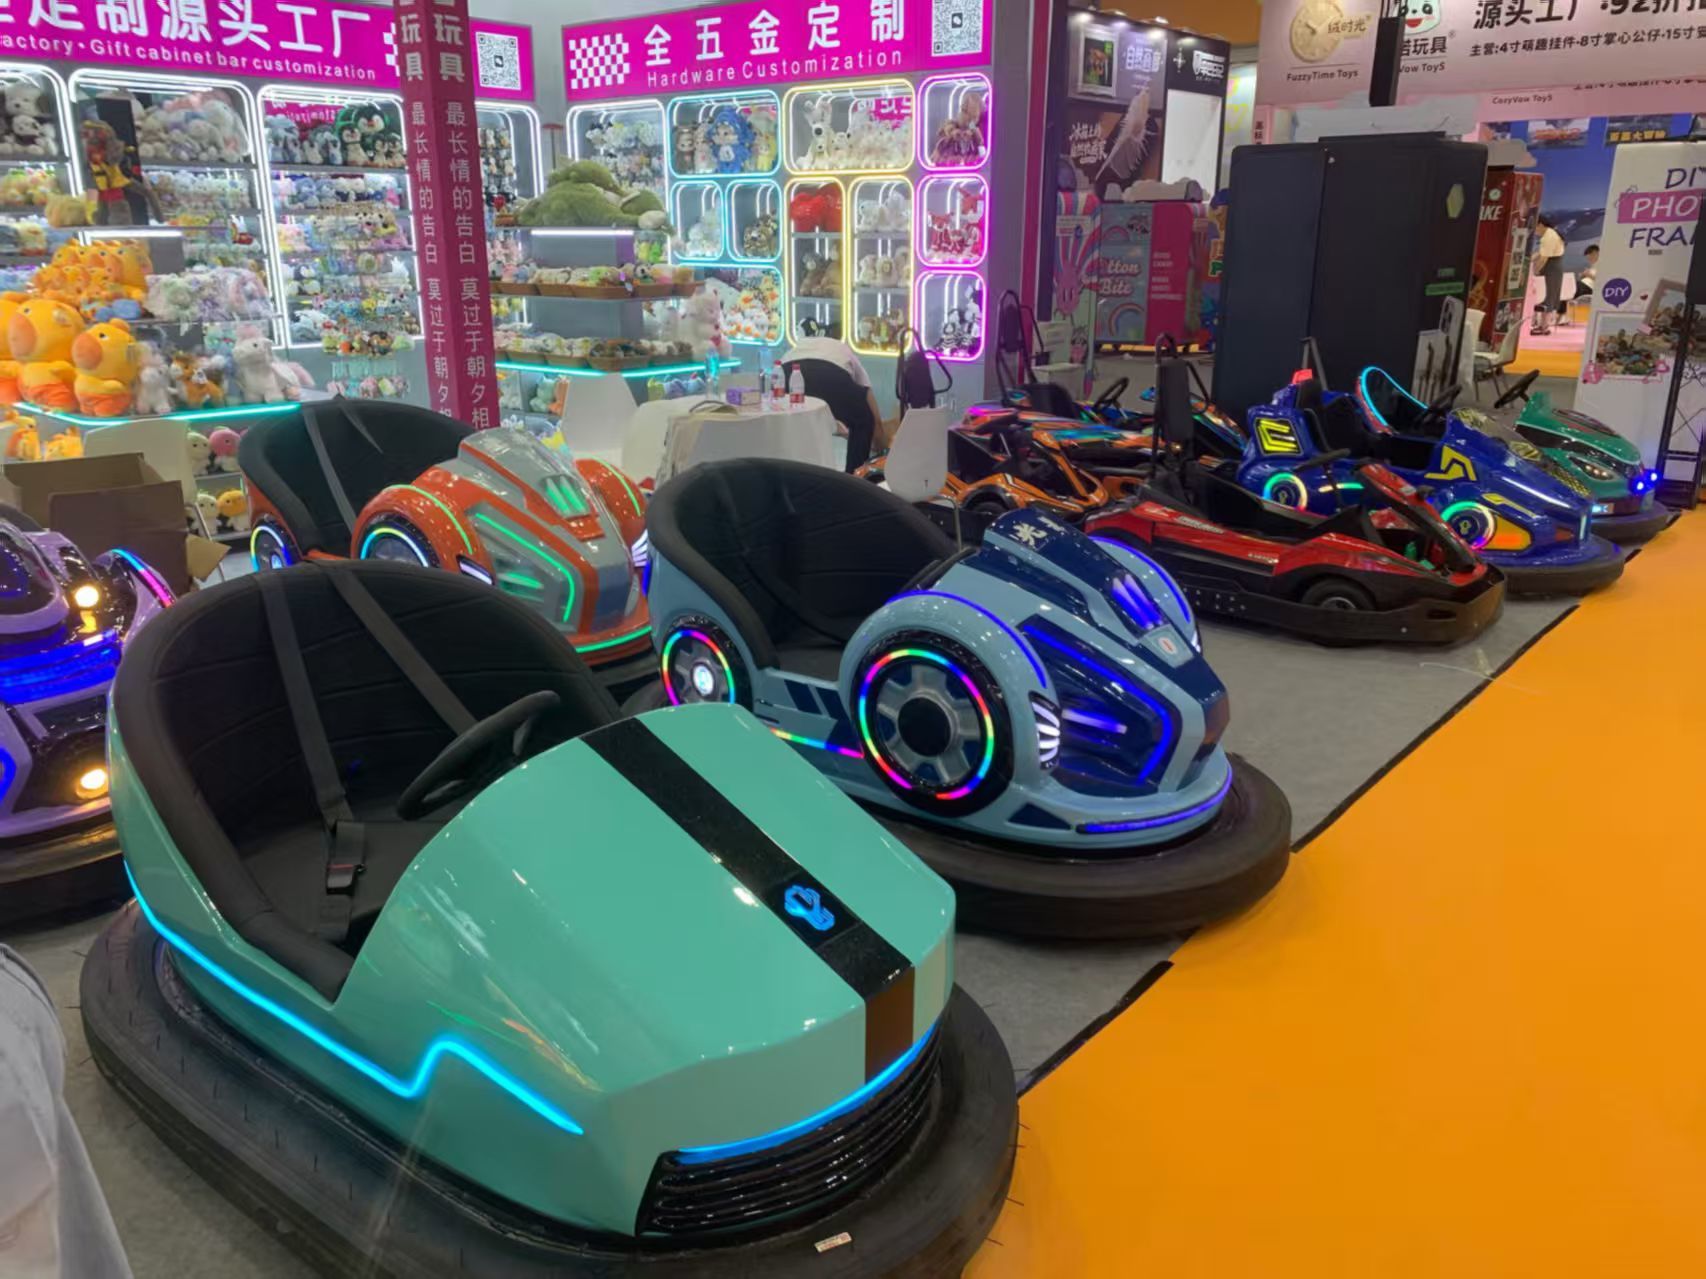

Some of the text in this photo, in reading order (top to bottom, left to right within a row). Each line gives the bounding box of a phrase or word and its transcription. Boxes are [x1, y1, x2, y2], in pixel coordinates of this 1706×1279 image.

[0, 0, 371, 58] 定制源头工厂
[400, 0, 424, 81] 玩具
[433, 0, 465, 82] 玩具
[643, 0, 905, 67] 全五金定制
[0, 34, 376, 80] actory Gift cabinet bar customization
[647, 50, 902, 88] Hardware Customization
[1286, 69, 1359, 82] FuzzyTime Toys
[411, 101, 438, 264] 最长情的告白
[445, 101, 476, 265] 最长情的告白
[1479, 205, 1504, 221] AKE
[1631, 195, 1699, 219] PHO
[1629, 225, 1696, 249] FRA
[1604, 285, 1629, 298] DIY
